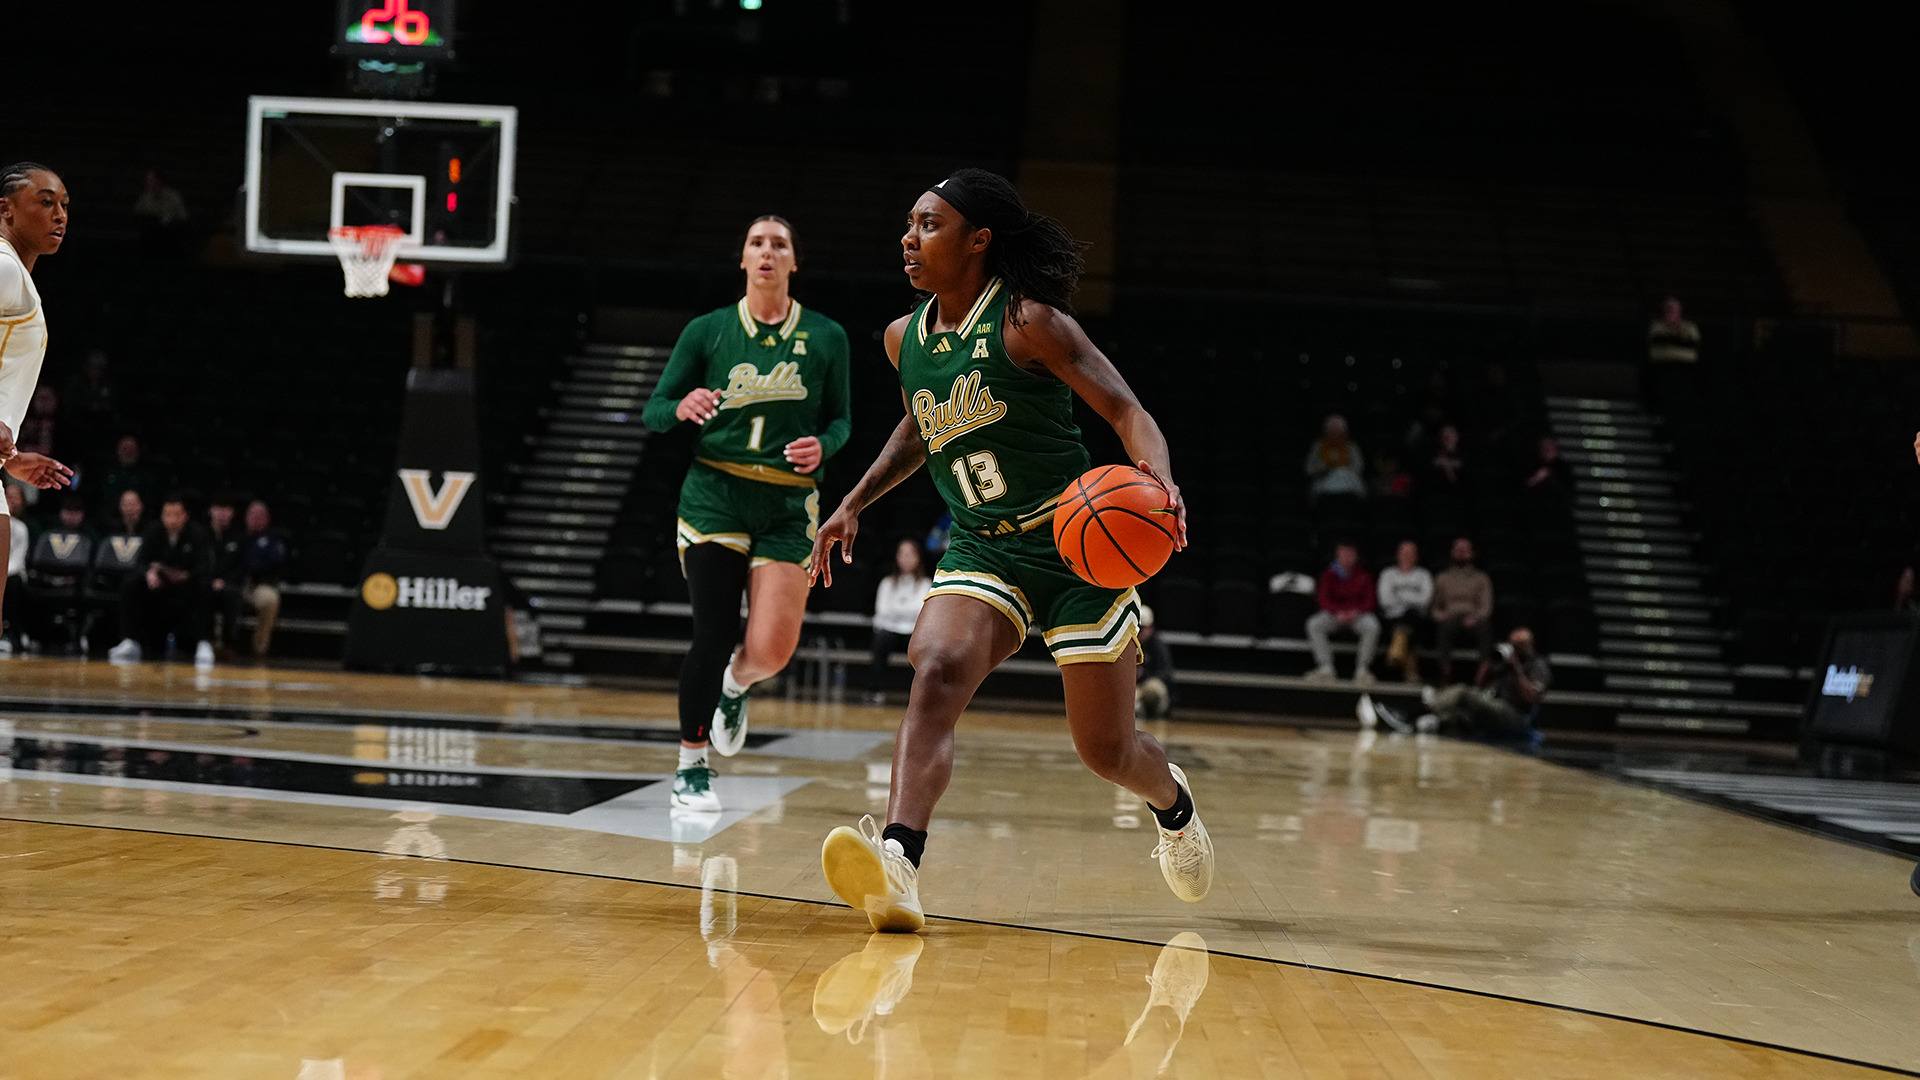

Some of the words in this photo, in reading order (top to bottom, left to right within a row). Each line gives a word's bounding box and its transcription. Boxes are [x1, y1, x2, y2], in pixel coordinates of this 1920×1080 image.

[972, 338, 989, 359] A
[976, 323, 991, 334] AAR
[720, 361, 807, 406] Bulls
[912, 370, 1007, 448] Bulls
[746, 415, 766, 452] 1
[398, 468, 477, 530] V
[951, 449, 1008, 509] 13
[397, 576, 491, 610] Hiller
